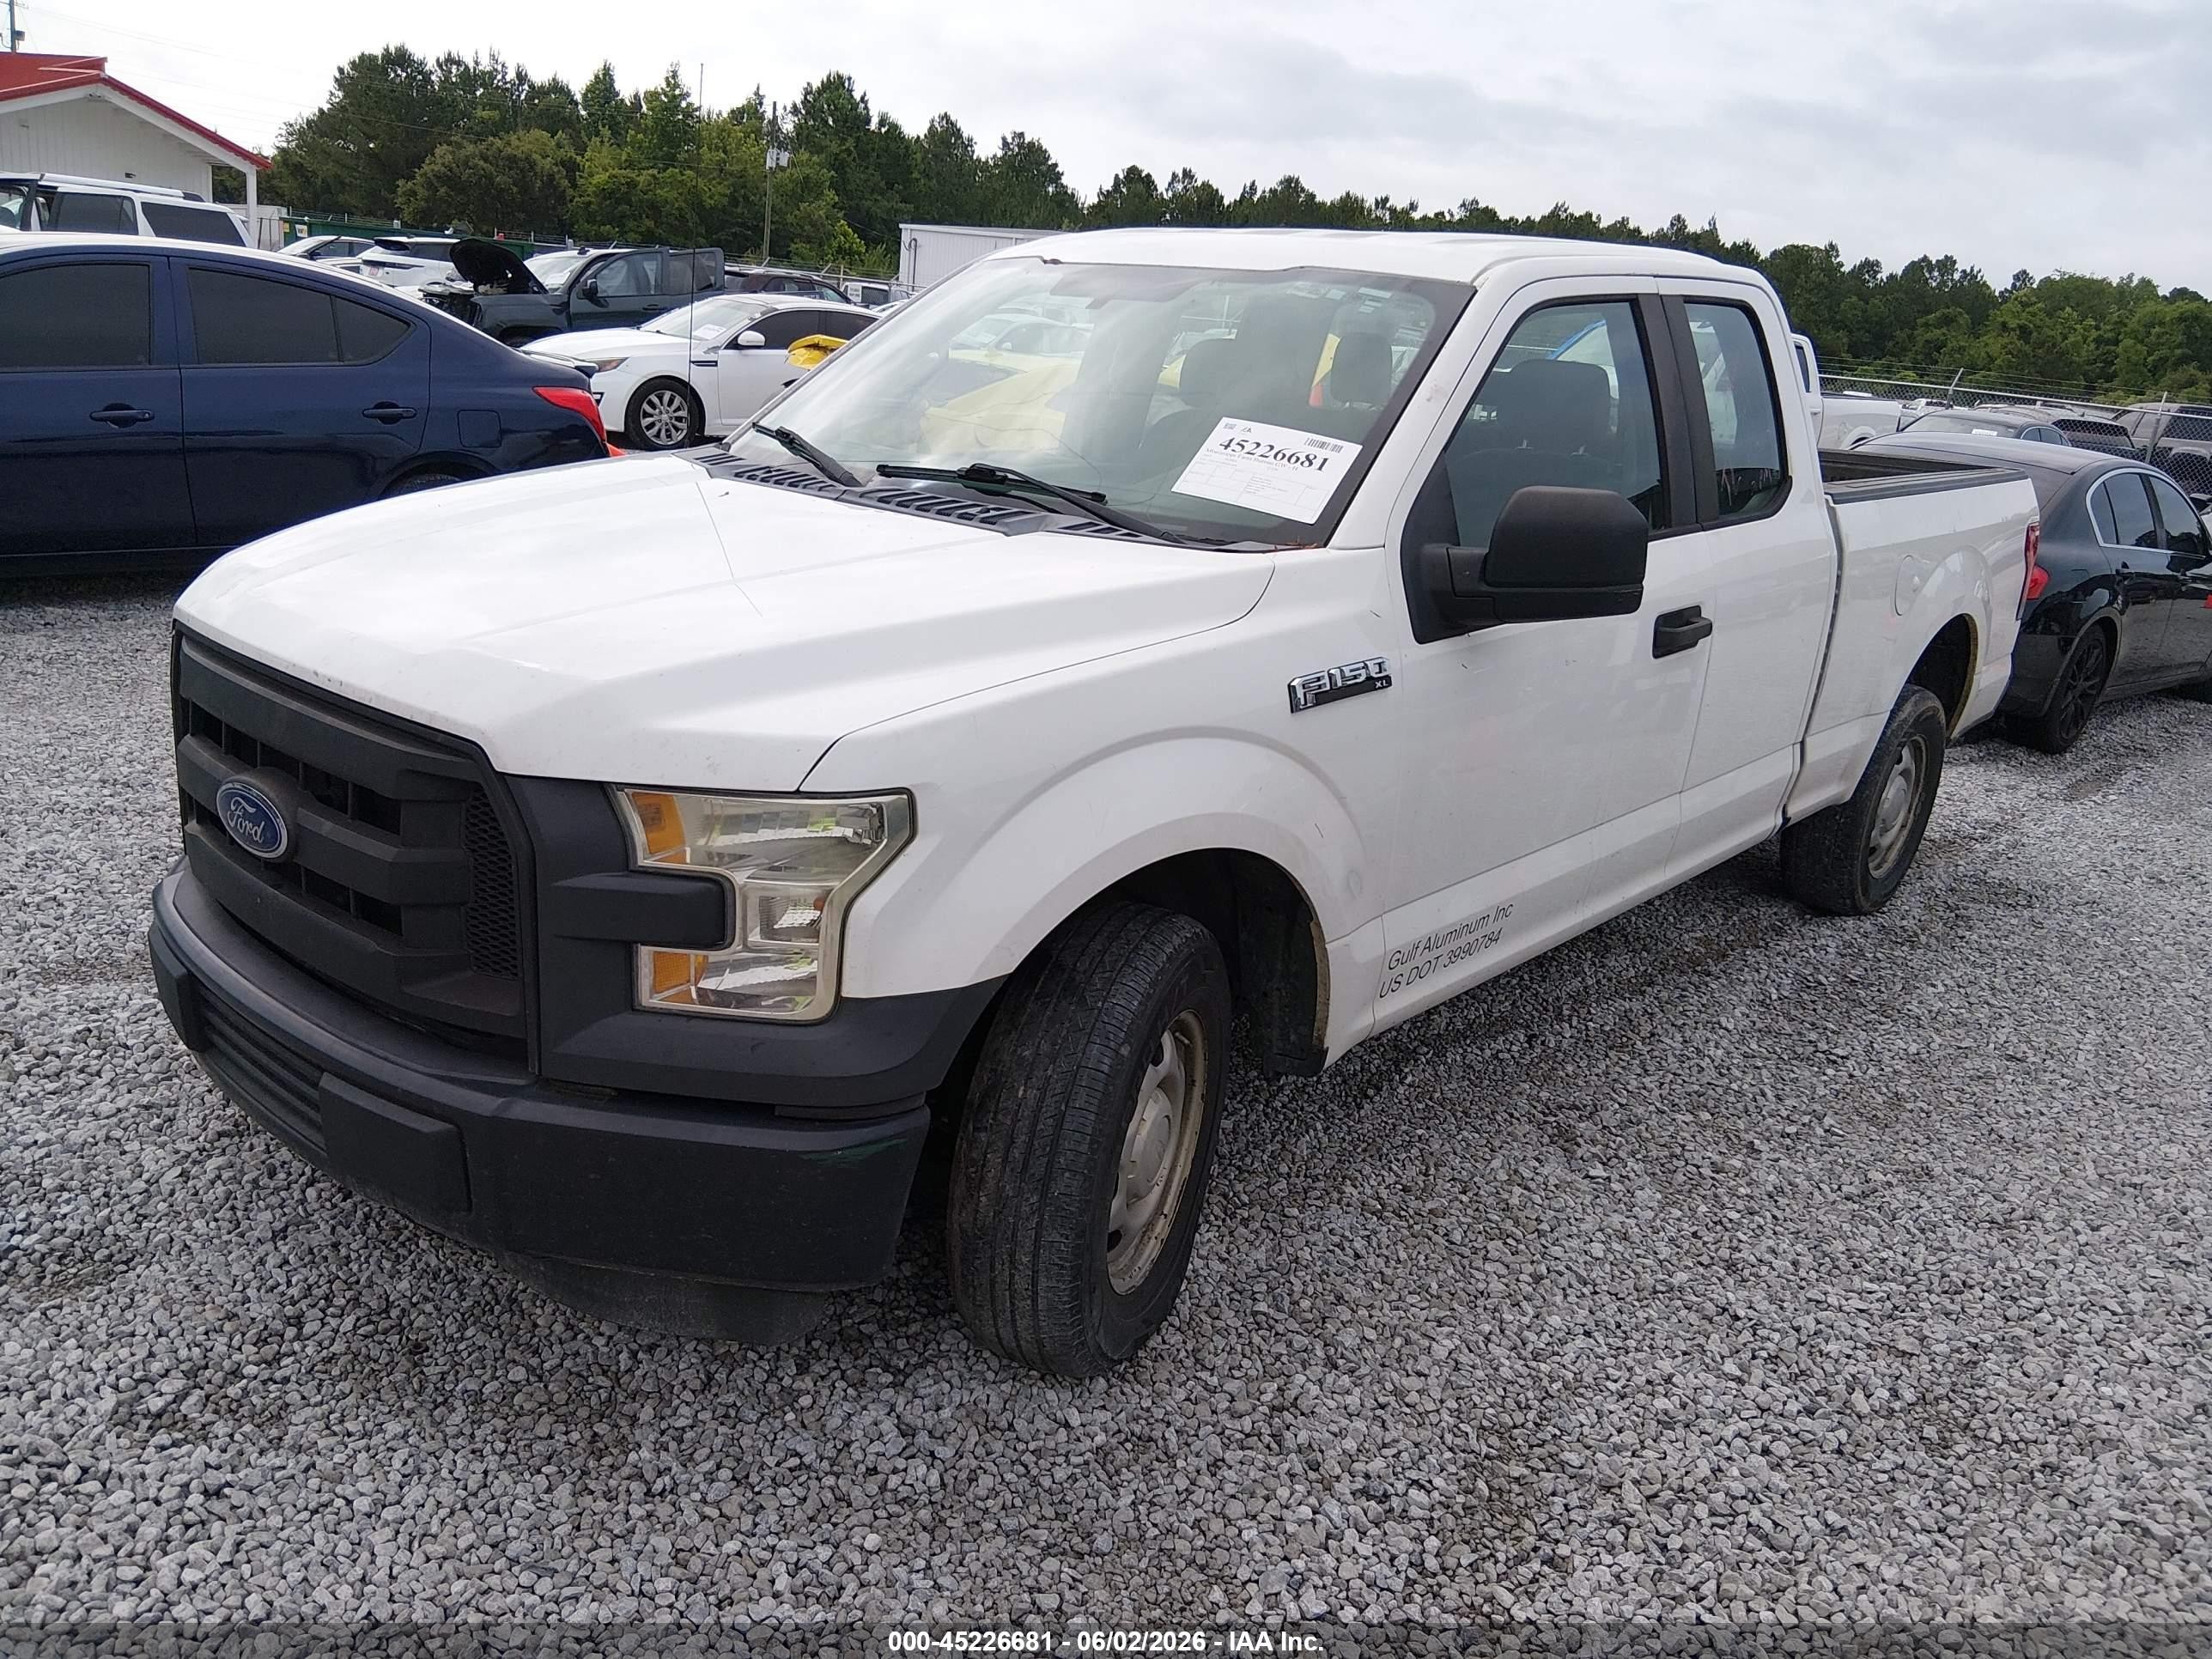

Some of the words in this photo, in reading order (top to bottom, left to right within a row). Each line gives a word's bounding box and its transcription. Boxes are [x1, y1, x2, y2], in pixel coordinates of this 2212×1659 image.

[1219, 437, 1330, 472] 45226681
[1375, 680, 1389, 689] XL
[228, 797, 265, 843] Ford
[1389, 939, 1422, 970] Gulf
[1420, 914, 1490, 957] Aluminum
[1492, 903, 1514, 923] Inc
[1379, 974, 1404, 999] US
[1406, 954, 1443, 986] DOT
[1443, 927, 1504, 969] 3990784
